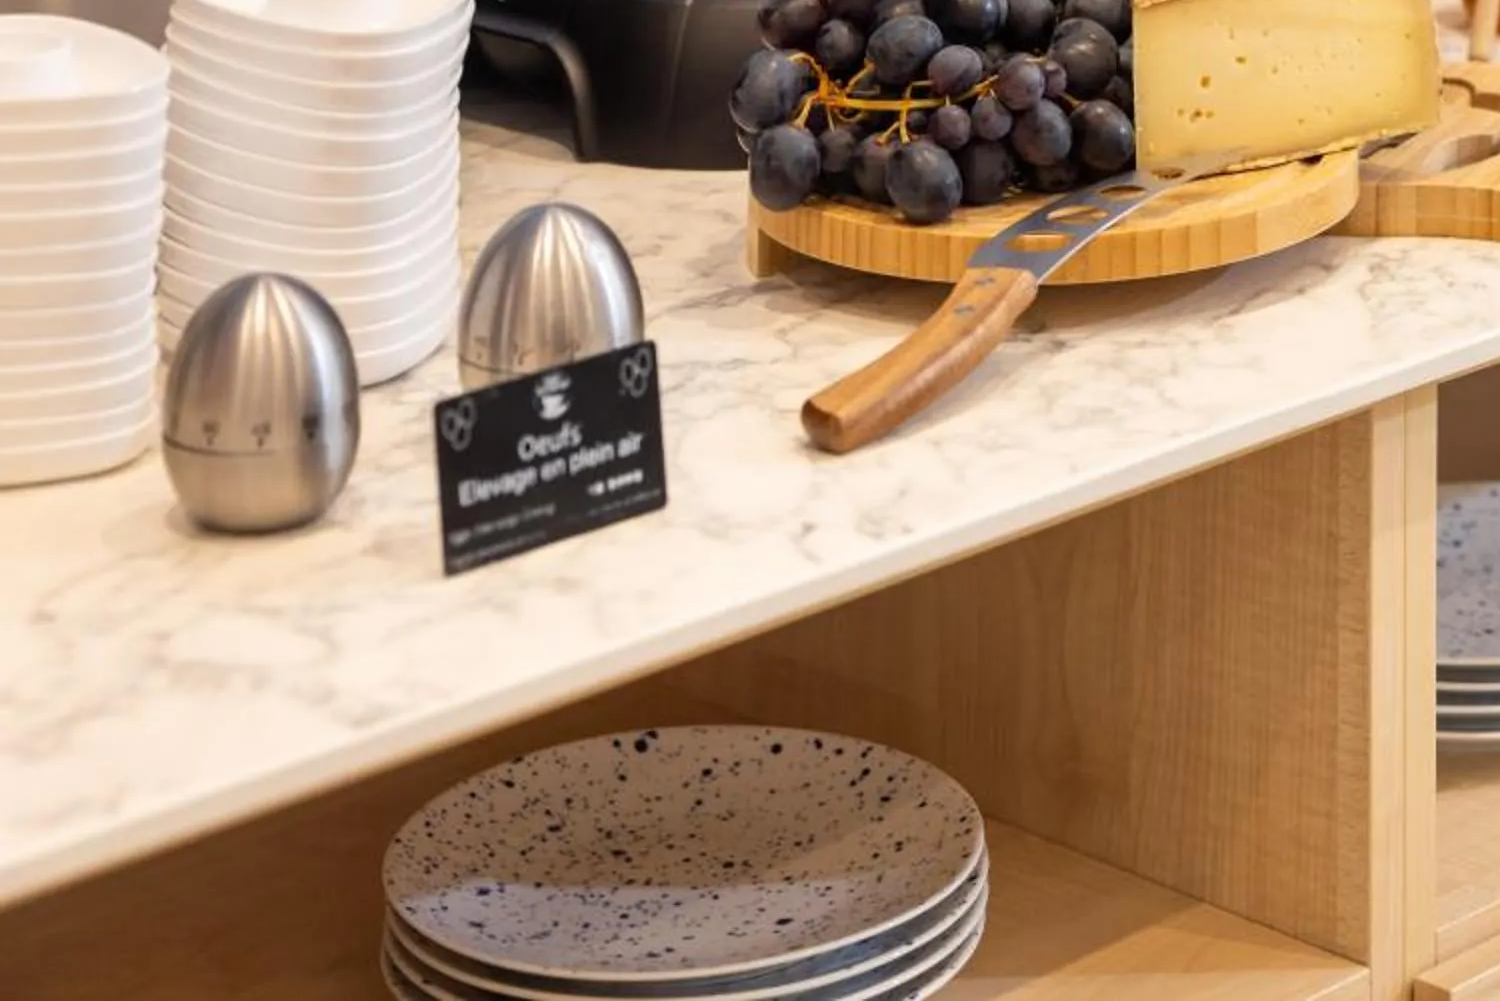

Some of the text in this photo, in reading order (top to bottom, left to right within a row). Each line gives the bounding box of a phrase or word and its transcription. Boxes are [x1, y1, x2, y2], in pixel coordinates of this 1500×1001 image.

[517, 420, 583, 462] Oeufs
[540, 456, 567, 482] en
[568, 442, 615, 475] plein
[617, 431, 644, 459] air
